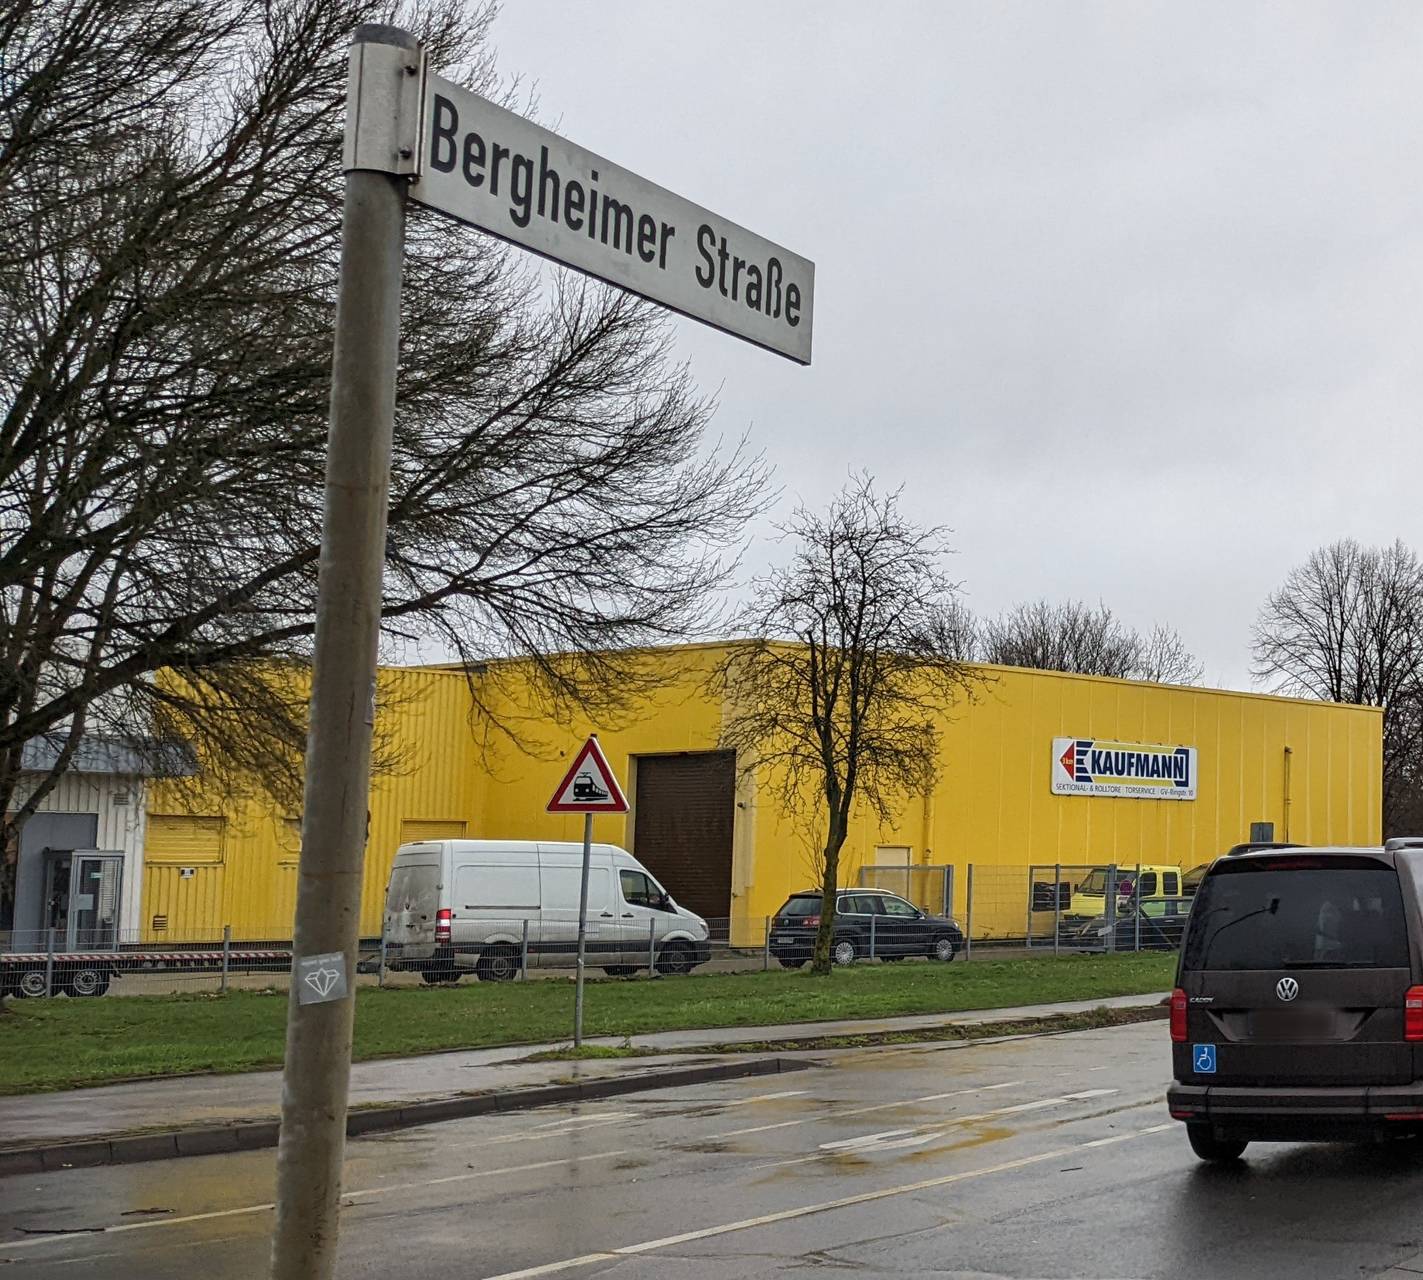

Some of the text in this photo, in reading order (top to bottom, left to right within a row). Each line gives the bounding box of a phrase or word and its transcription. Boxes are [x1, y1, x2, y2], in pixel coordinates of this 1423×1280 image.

[430, 94, 801, 327] Bergheimer Straße
[1091, 750, 1185, 779] KAUFMANN
[1095, 784, 1121, 793] ROLLTORE
[1125, 786, 1155, 795] TORSERVICE
